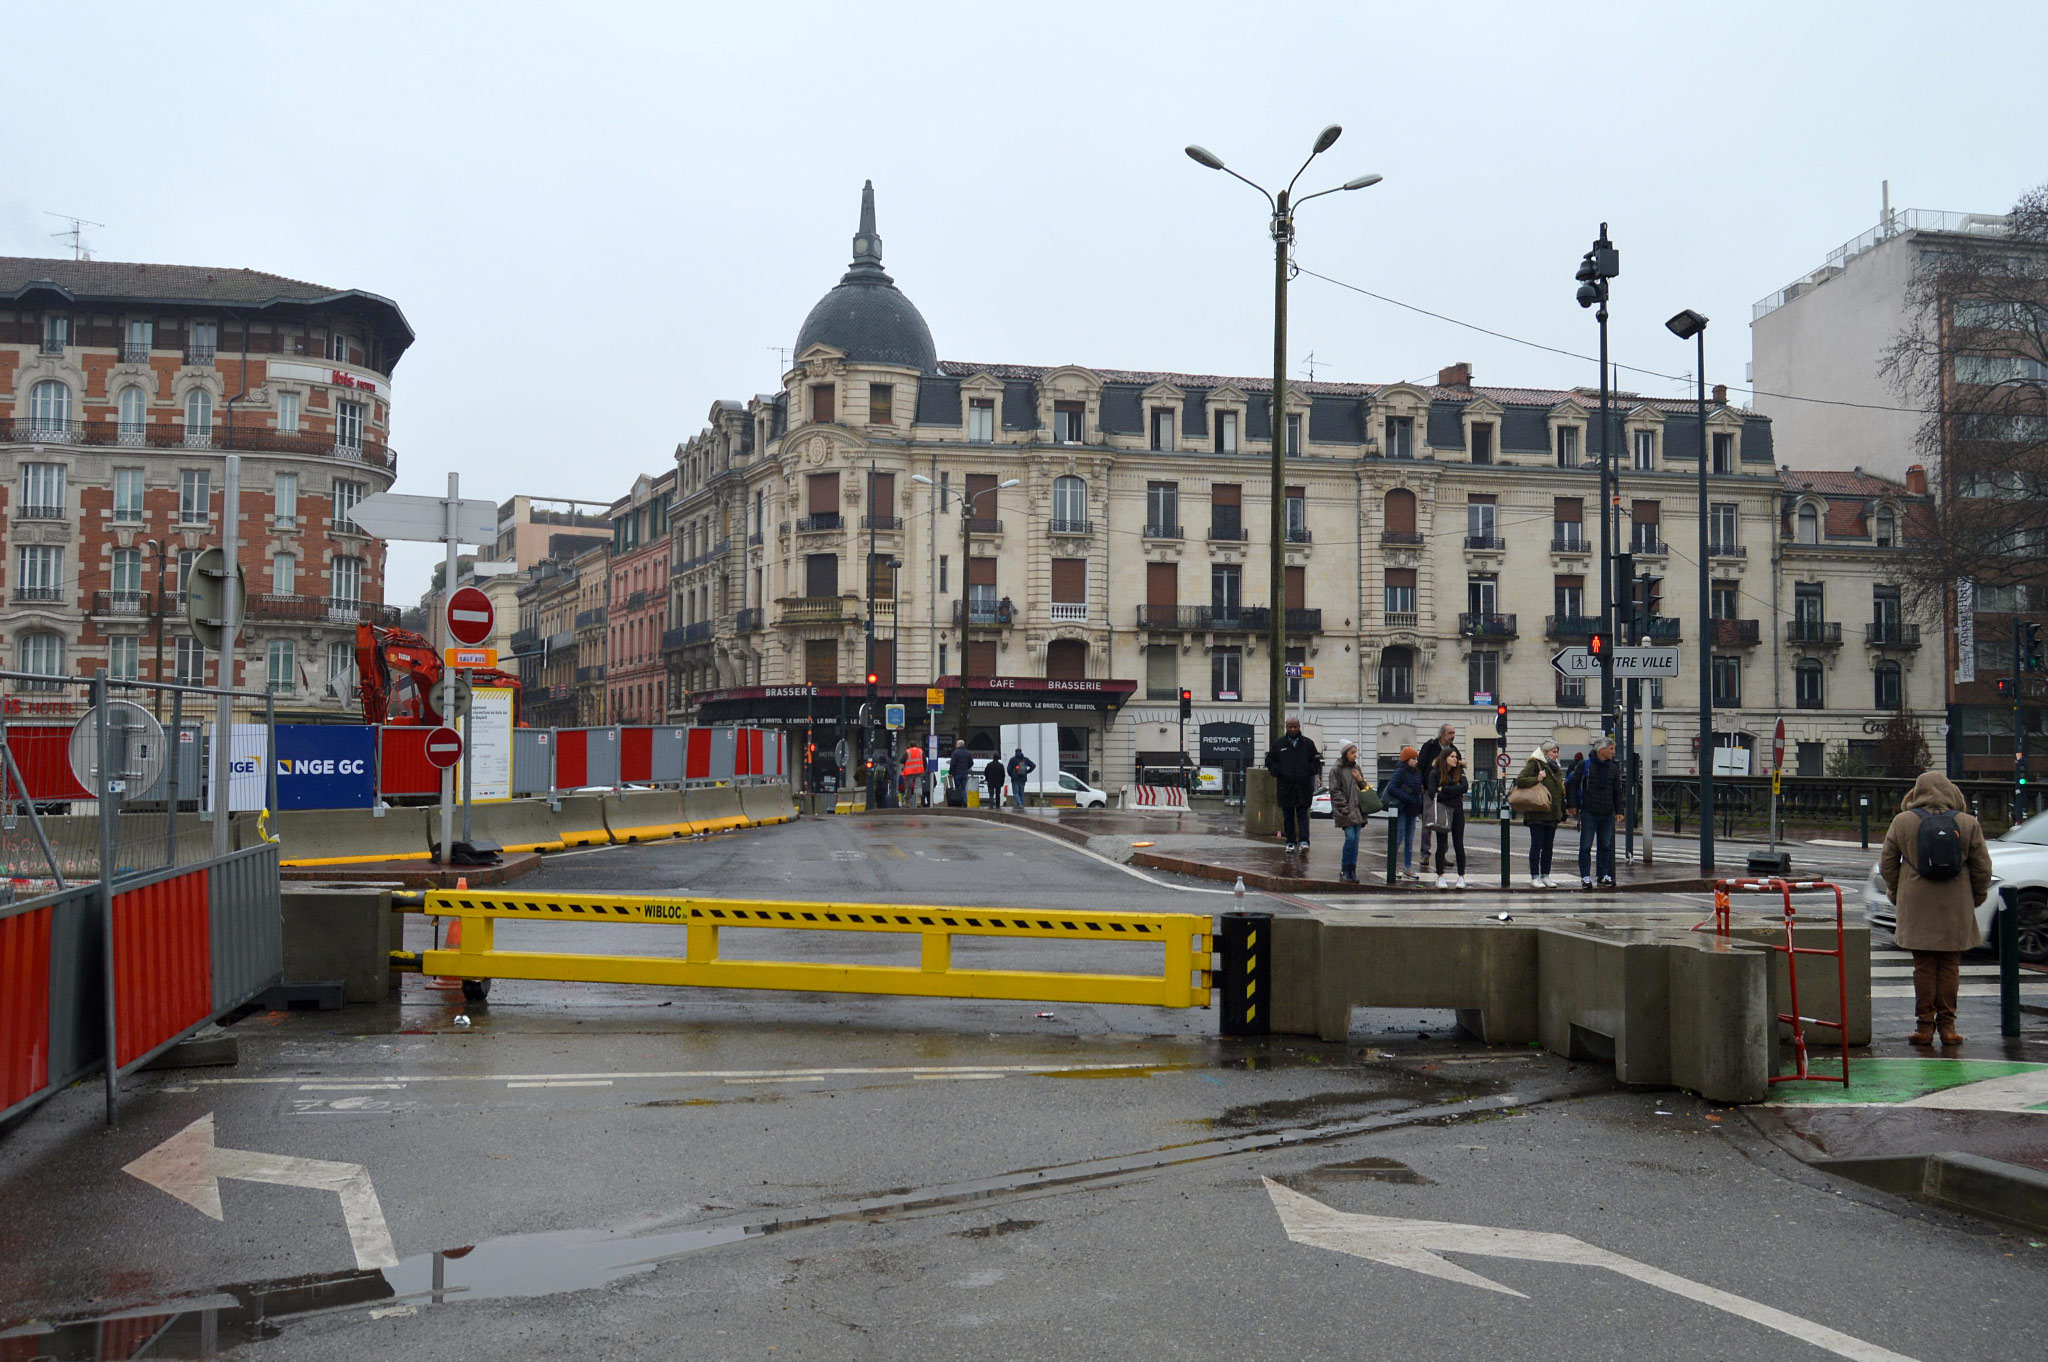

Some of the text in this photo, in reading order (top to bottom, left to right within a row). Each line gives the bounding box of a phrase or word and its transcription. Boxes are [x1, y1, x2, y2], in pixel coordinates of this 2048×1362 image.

[332, 370, 354, 387] ibis
[1591, 657, 1673, 668] CTRE VILLE
[990, 680, 1102, 690] CAFE BRASSERIE
[765, 688, 817, 697] BRASSERE
[28, 702, 76, 715] HOTEL
[295, 759, 364, 775] NGE GC
[644, 904, 682, 919] WIBLOC
